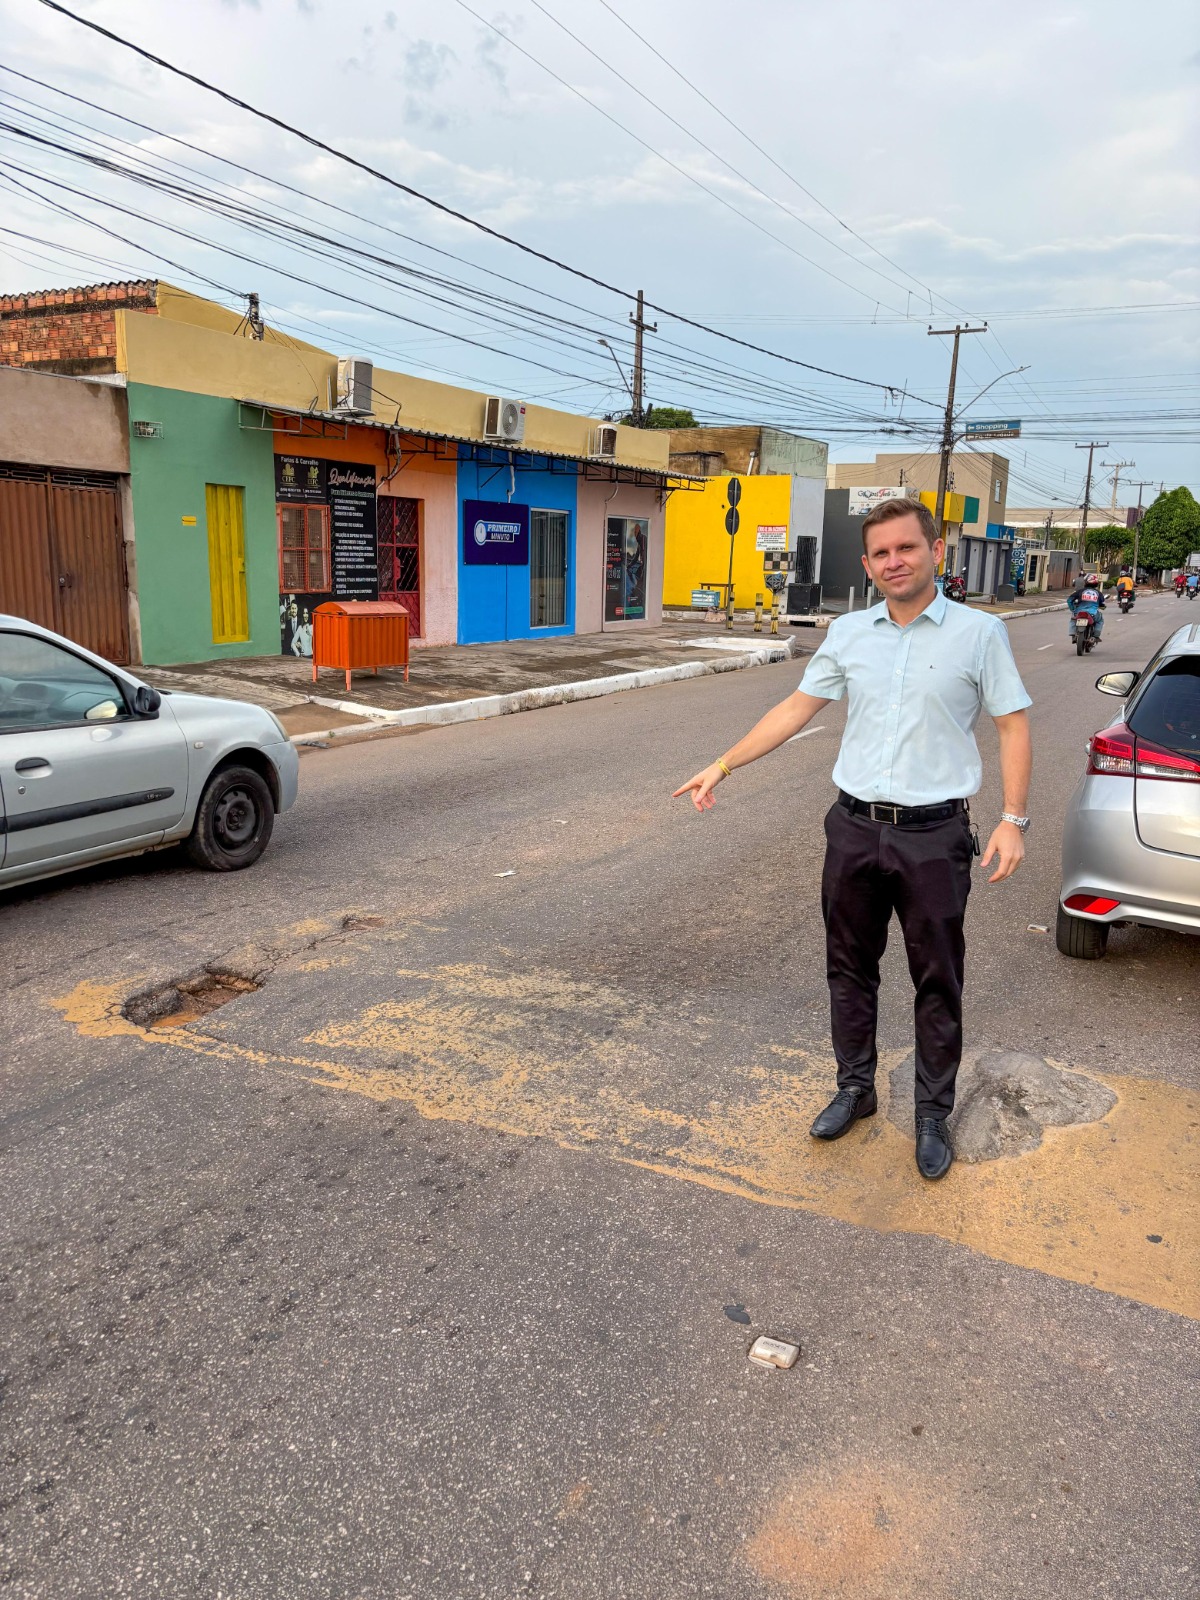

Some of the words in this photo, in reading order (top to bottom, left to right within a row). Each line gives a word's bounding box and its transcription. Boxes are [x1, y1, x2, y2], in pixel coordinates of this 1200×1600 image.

[975, 423, 1008, 431] Shopping
[299, 458, 320, 466] Carvalho
[487, 524, 518, 533] PRIMEIRO
[491, 533, 510, 541] MINUTO
